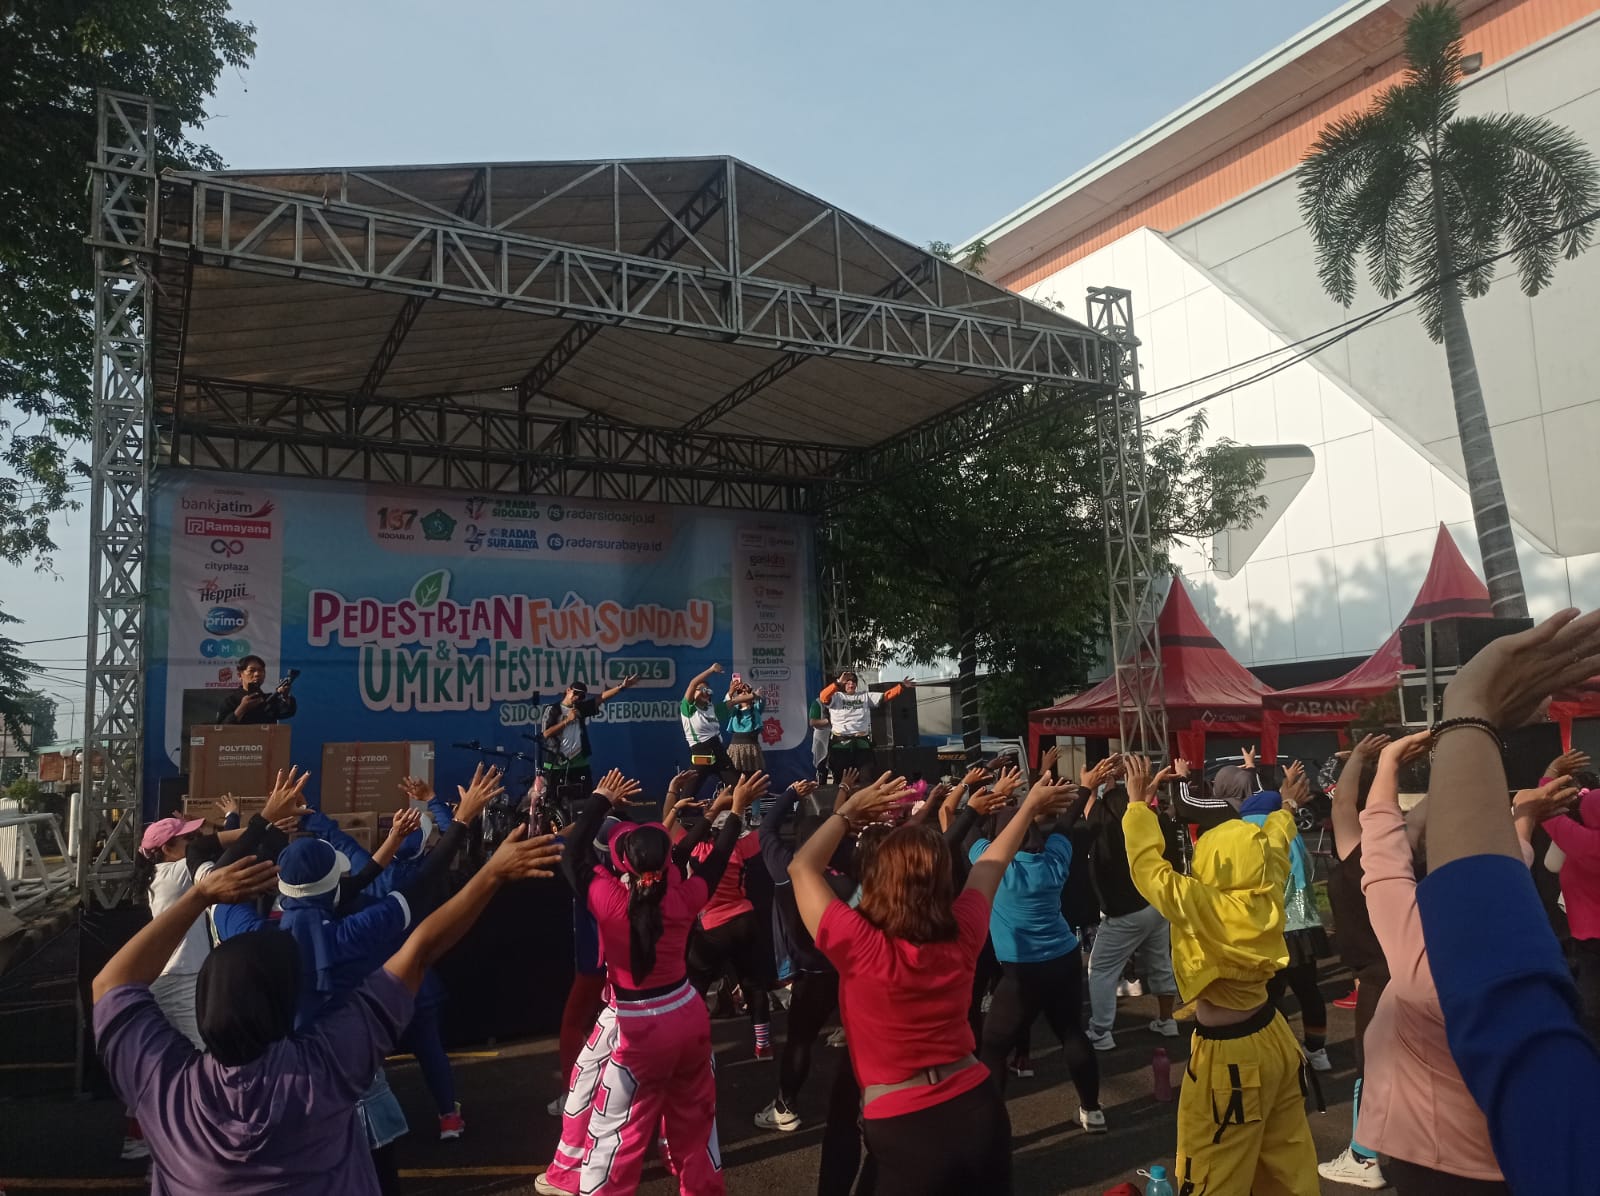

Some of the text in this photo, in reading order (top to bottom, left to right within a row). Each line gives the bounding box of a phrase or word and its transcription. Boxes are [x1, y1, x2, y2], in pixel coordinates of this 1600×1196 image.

[182, 497, 253, 514] bankjatim
[491, 509, 540, 520] SIDOARJO
[566, 508, 655, 524] radarsidoarjo.id
[206, 521, 269, 535] Ramayana
[500, 529, 537, 540] RADAR
[486, 539, 539, 550] SURABAYA
[566, 537, 662, 552] radarsurabaya.id
[205, 562, 249, 572] cityplaza
[206, 614, 245, 629] prima
[528, 600, 591, 646] FUN
[598, 602, 709, 645] SUNDAY
[753, 622, 785, 634] ASTON
[436, 640, 450, 661] &
[752, 647, 785, 657] KOMIX
[365, 641, 662, 704] UMKM FESTIVAL 2026
[501, 703, 542, 723] SIDO
[609, 702, 677, 720] FEBRUARI
[1043, 713, 1097, 729] CABANG
